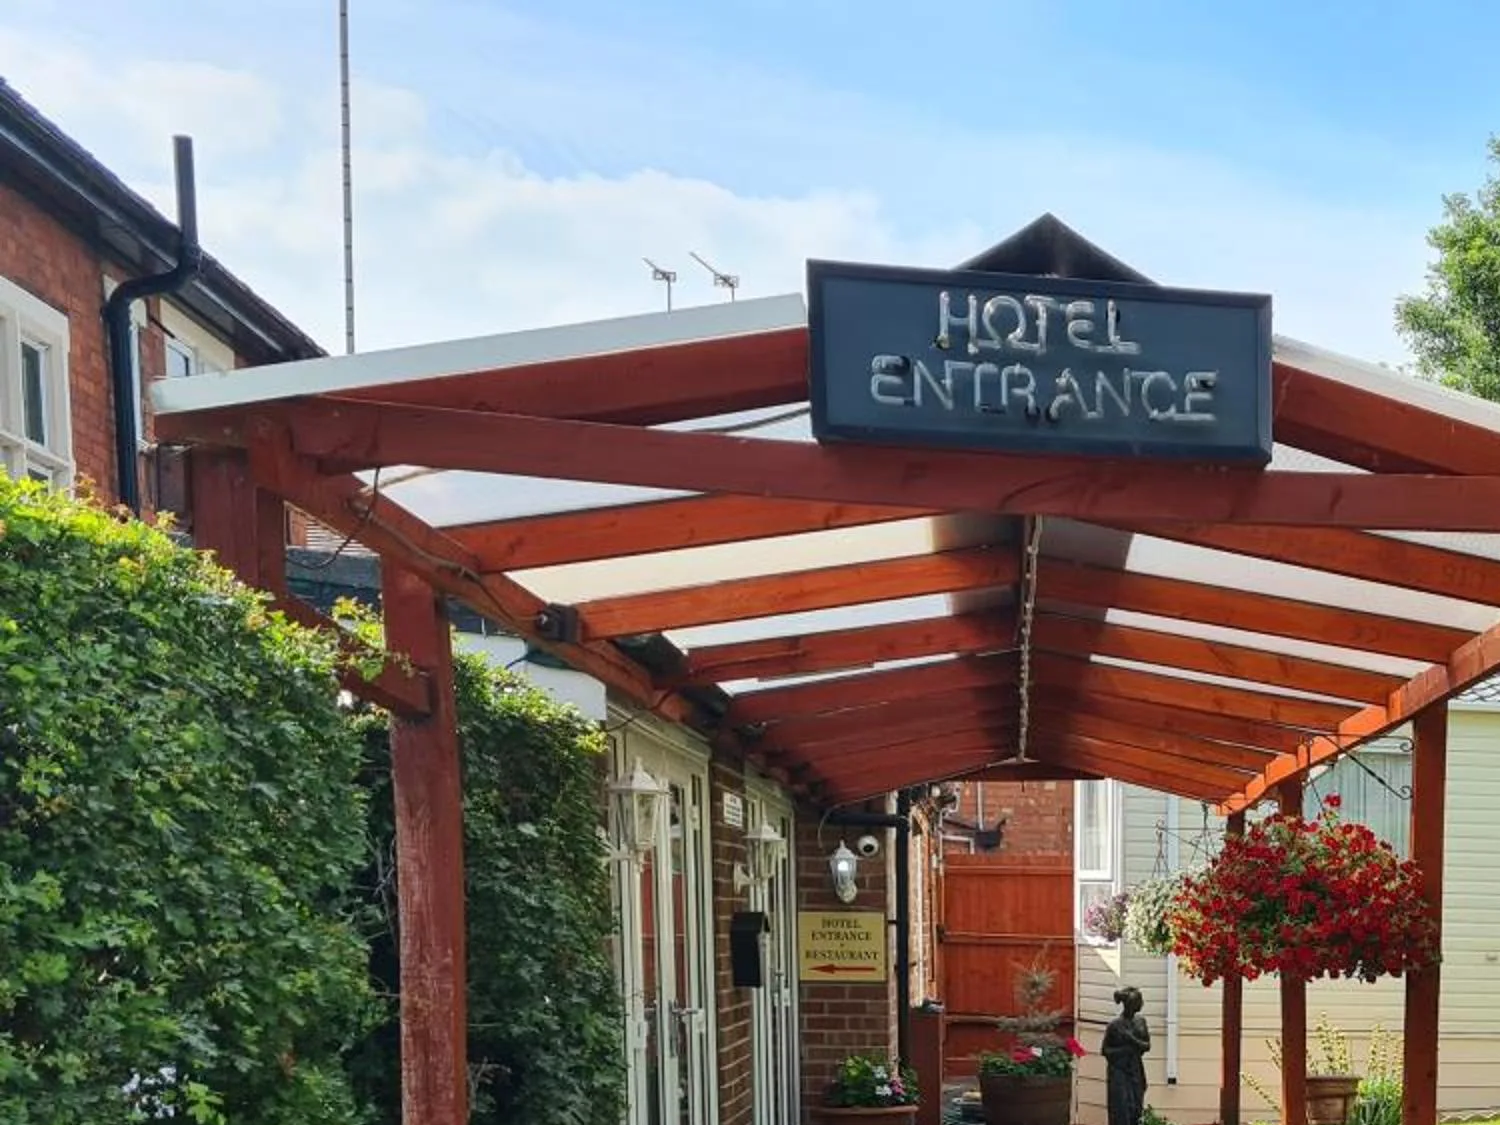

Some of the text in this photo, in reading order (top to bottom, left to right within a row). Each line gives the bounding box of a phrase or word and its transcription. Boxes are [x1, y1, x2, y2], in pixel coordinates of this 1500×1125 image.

[937, 291, 1141, 355] HOTEL
[870, 355, 1219, 423] ENTRANCE
[821, 917, 862, 929] HOTEL
[811, 930, 873, 941] ENTRANCE
[805, 949, 879, 960] RESTAURANT
